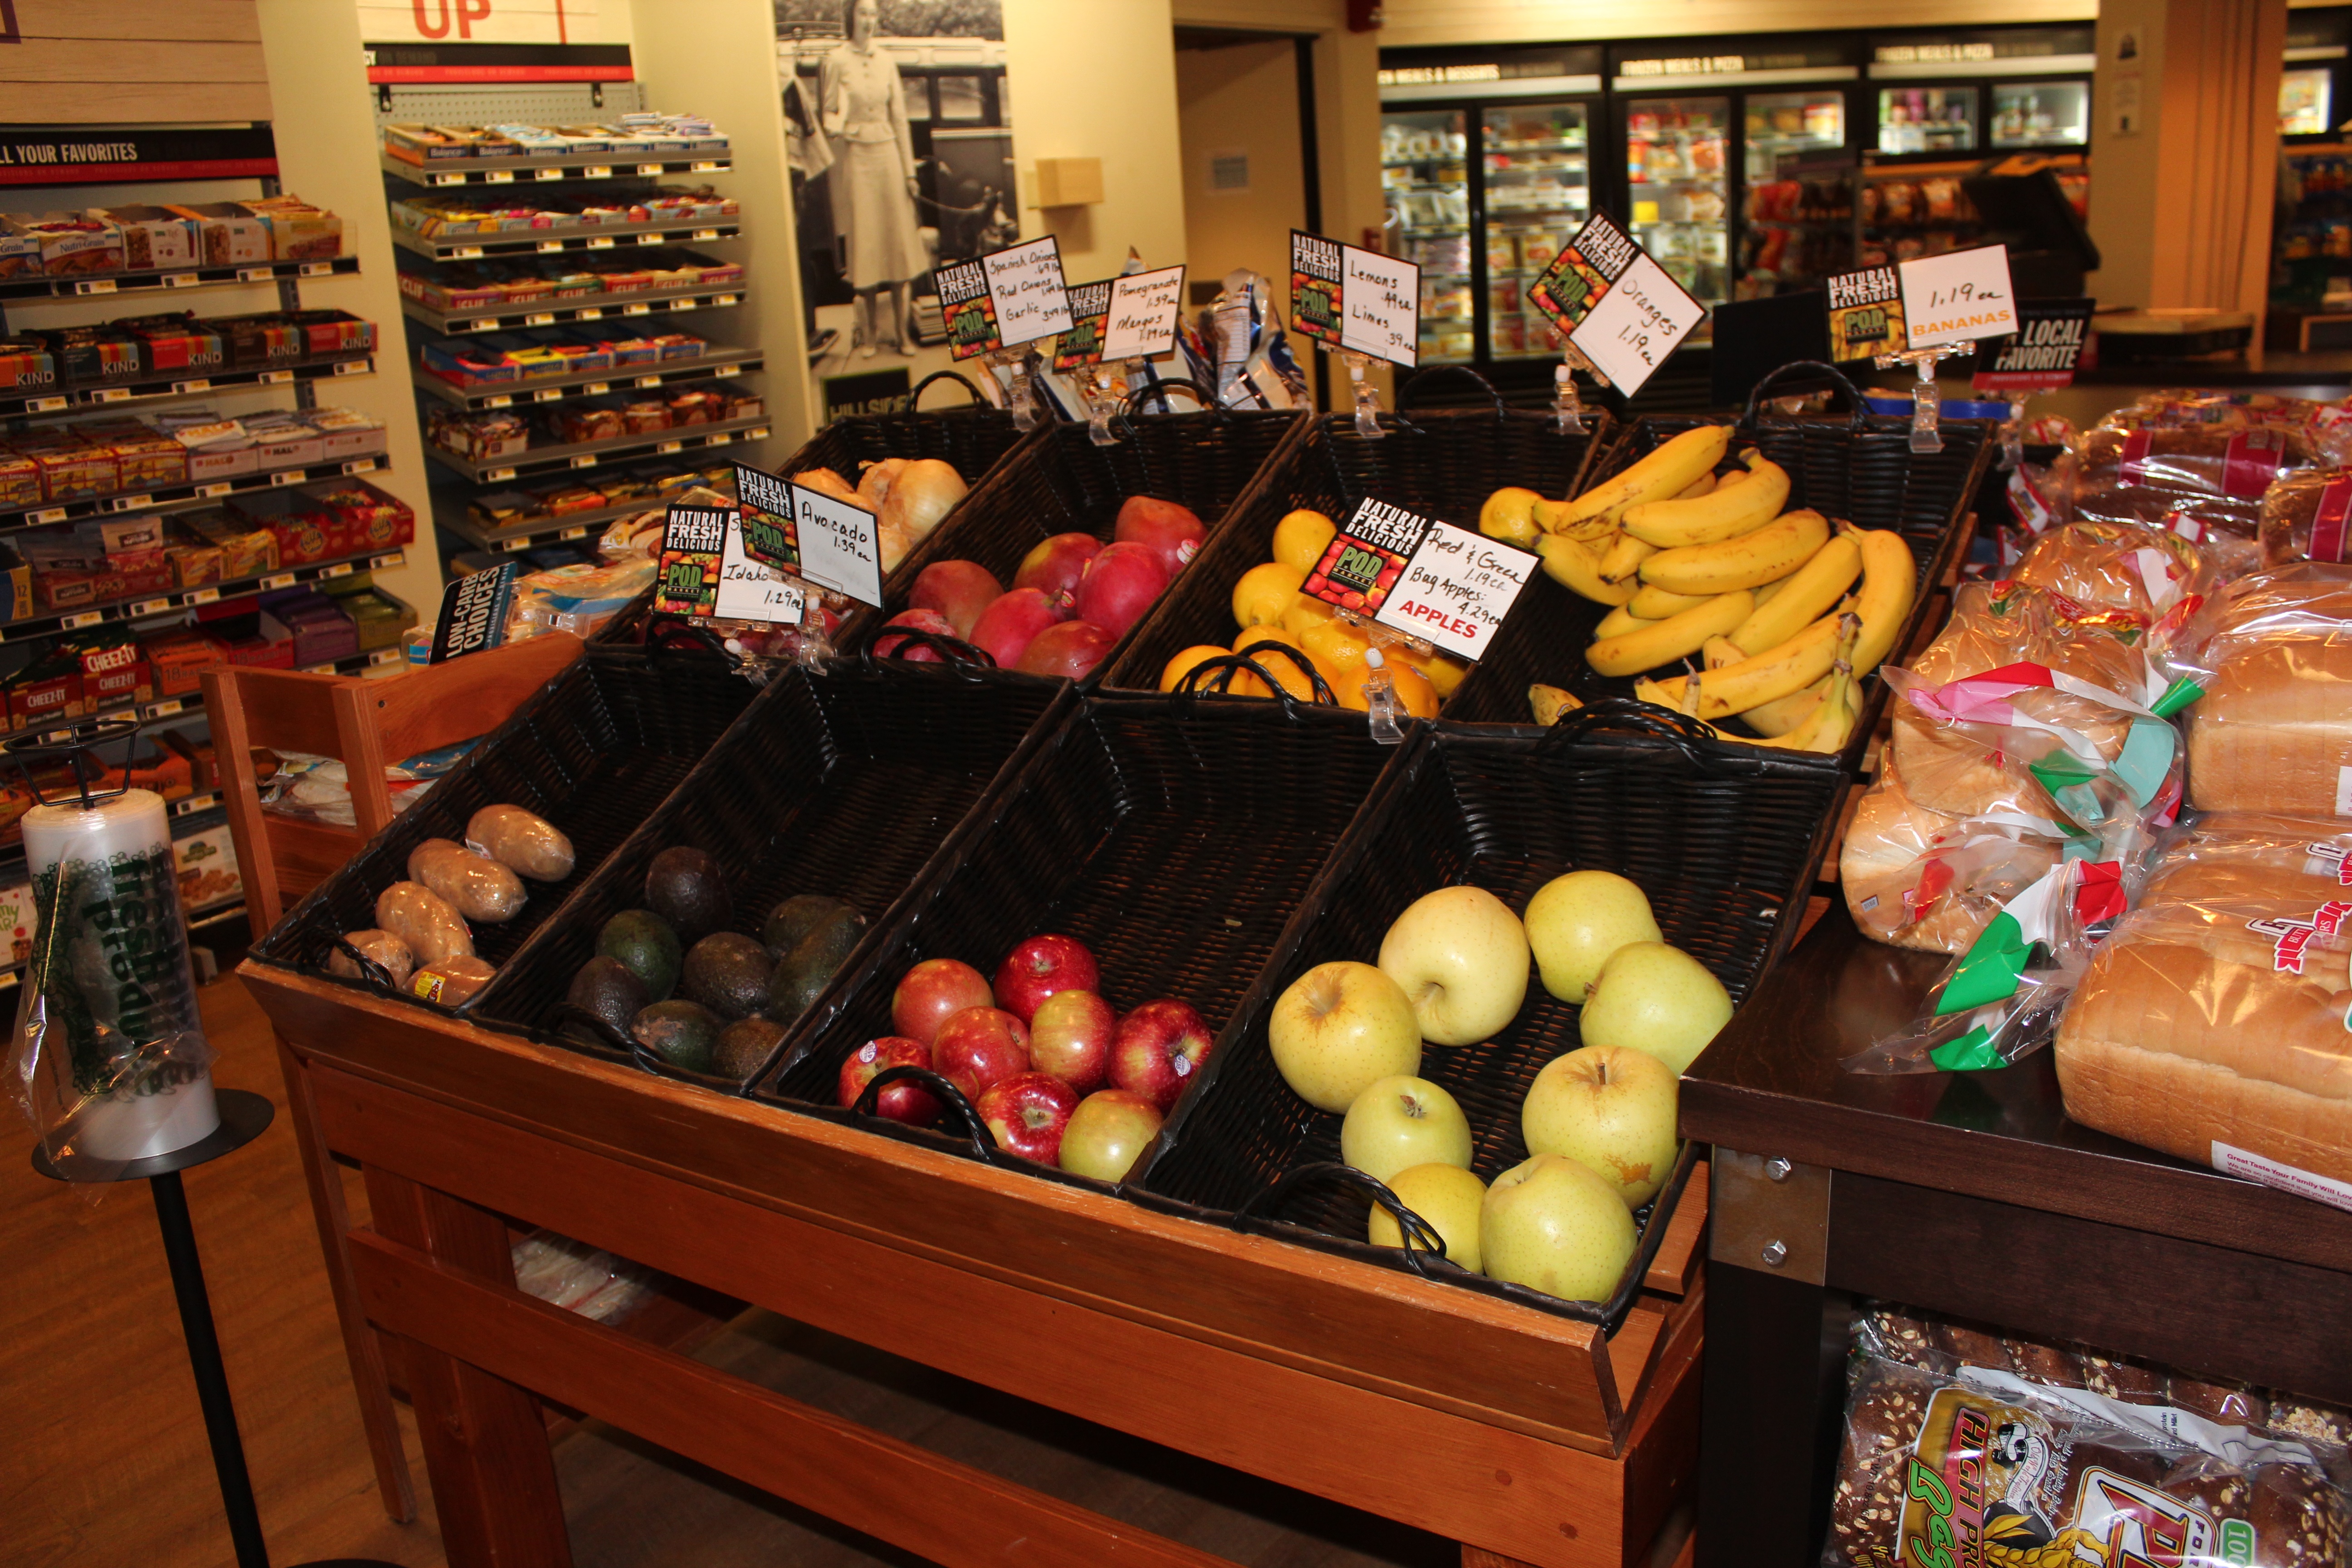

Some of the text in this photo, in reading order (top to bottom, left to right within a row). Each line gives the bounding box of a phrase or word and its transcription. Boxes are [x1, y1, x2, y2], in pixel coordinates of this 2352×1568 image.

[16, 145, 58, 163] YOUR
[61, 143, 137, 162] FAVORITES
[59, 238, 105, 253] Nutri-Grain
[1293, 233, 1340, 259] NATURAL
[1581, 225, 1630, 272] FRESH
[1590, 213, 1636, 261] NATURAL
[1294, 247, 1340, 271] FRESH
[1294, 259, 1340, 282] DELICIOUS
[1573, 237, 1618, 281] DELICIOUS
[936, 261, 982, 284] NATURAL
[940, 273, 985, 295] FRESH
[1350, 259, 1398, 289] Lemons
[1828, 266, 1896, 289] NATURAL
[942, 284, 987, 305] DELICIOUS
[1119, 275, 1179, 298] Pomegranate
[1829, 277, 1897, 300] FRESH
[1930, 282, 1975, 308] 1.19
[1071, 294, 1109, 310] RESH
[1622, 279, 1678, 336] Oranges
[1830, 288, 1898, 309] DELICIOUS
[1006, 301, 1040, 321] Garlic
[1073, 304, 1107, 318] LICIOUS
[1116, 314, 1163, 331] Mangos
[1352, 303, 1389, 329] Limes
[1912, 309, 2011, 337] BANANAS
[2022, 319, 2084, 346] LOCAL
[267, 343, 300, 358] KIND
[340, 336, 371, 350] KIND
[102, 360, 140, 376] KIND
[188, 351, 223, 366] KIND
[1994, 345, 2081, 371] FAVORITE
[15, 370, 55, 387] KIND
[737, 466, 789, 497] NATURAL
[739, 479, 791, 509] FRESH
[740, 491, 792, 519] DELICIOUS
[669, 510, 724, 528] NATURAL
[801, 501, 868, 543] Avocado
[1360, 497, 1427, 534] NATURAL
[668, 524, 723, 540] FRESH
[1345, 521, 1413, 556] DELICIOUS
[1351, 510, 1422, 546] FRESH
[666, 537, 720, 551] DELICIOUS
[722, 564, 769, 583] Idaho
[1331, 566, 1372, 586] MARKET
[1409, 566, 1438, 595] Bag
[446, 574, 479, 658] LOW-CARB
[463, 567, 500, 649] CHOICES
[1398, 599, 1479, 639] APPLES
[86, 645, 137, 673] CHEEZ-IT
[99, 671, 136, 691] CHEEZ-IT
[164, 667, 181, 681] 18
[27, 688, 66, 708] CHEEZ-IT
[2227, 1161, 2239, 1170] We
[2227, 1153, 2249, 1165] Great
[2249, 1161, 2270, 1172] Taste
[2271, 1168, 2290, 1180] Your
[2291, 1176, 2318, 1189] Family
[2319, 1184, 2335, 1194] Will
[1958, 1410, 1987, 1513] HIGH
